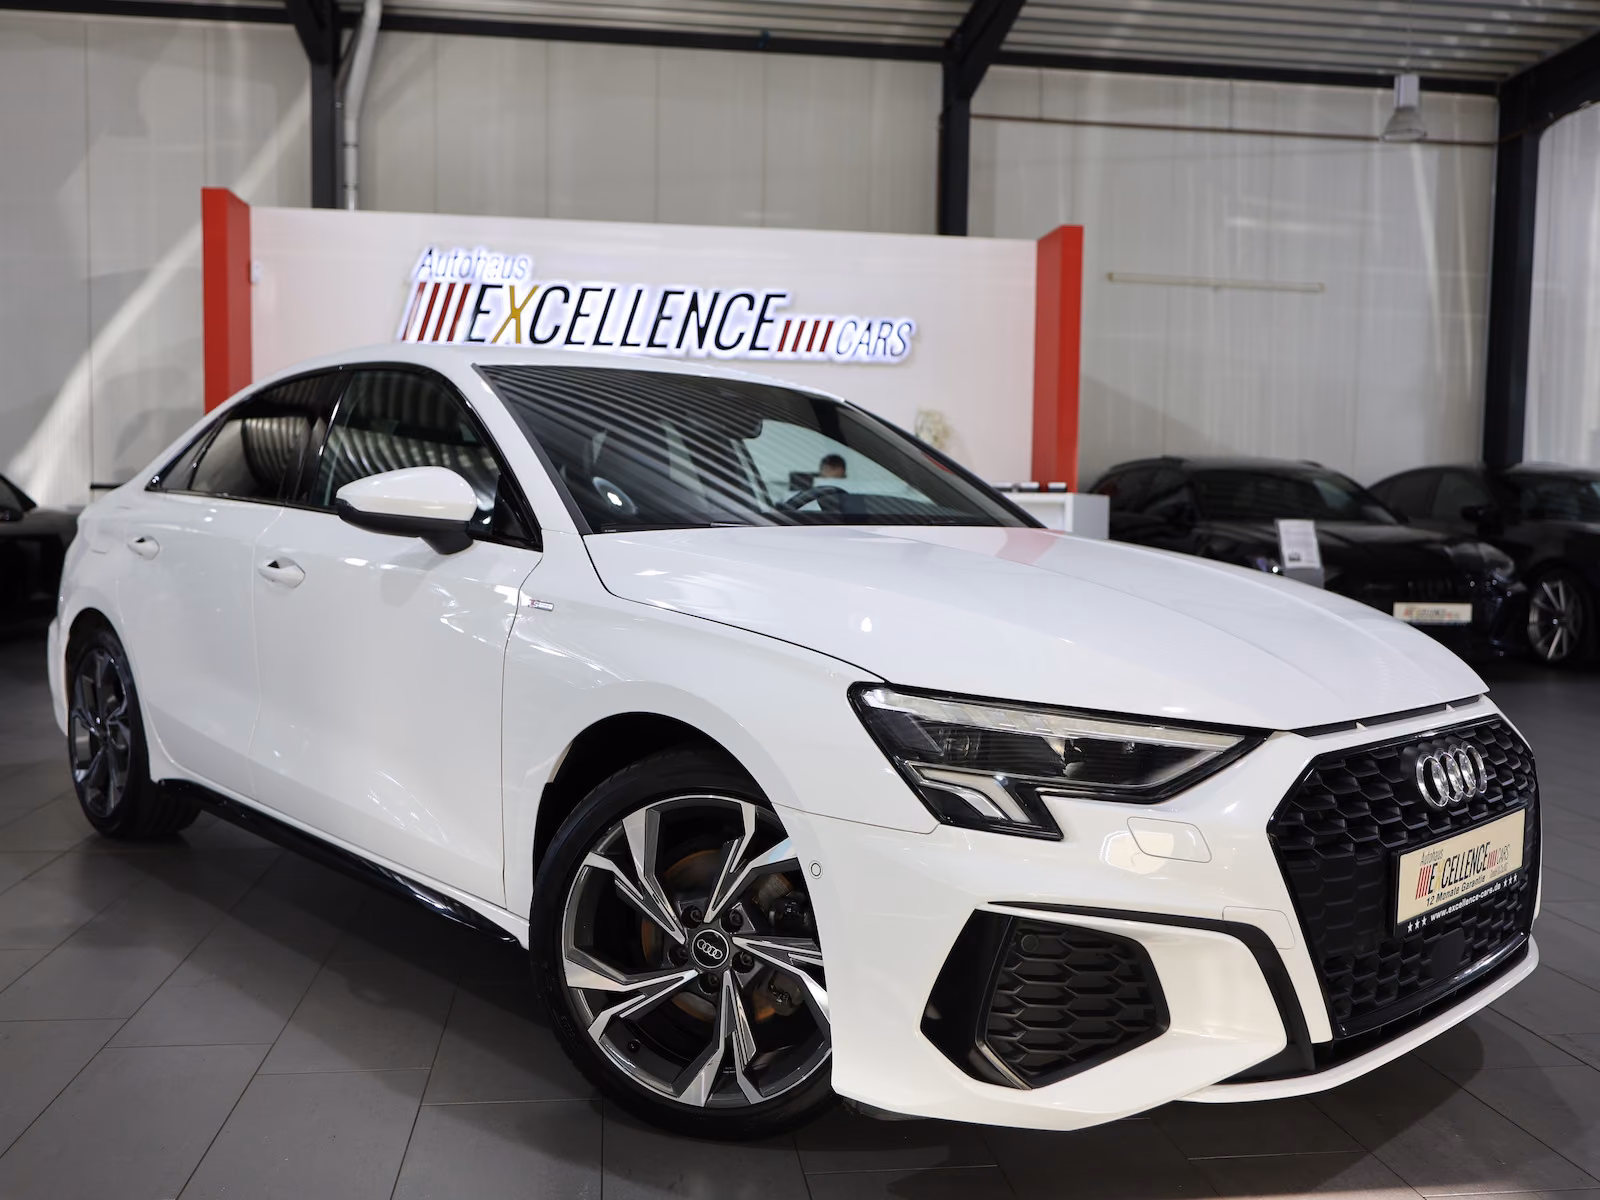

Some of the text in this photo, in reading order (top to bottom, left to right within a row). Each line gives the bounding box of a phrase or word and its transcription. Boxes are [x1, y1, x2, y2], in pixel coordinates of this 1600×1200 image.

[415, 248, 529, 280] Autohaus
[467, 283, 913, 357] EXCELLENCE CARS
[1428, 842, 1491, 894] EXCELLENCE
[1427, 875, 1486, 907] 12 Monate Garantie
[1430, 883, 1501, 921] www.excellence-cars.de
